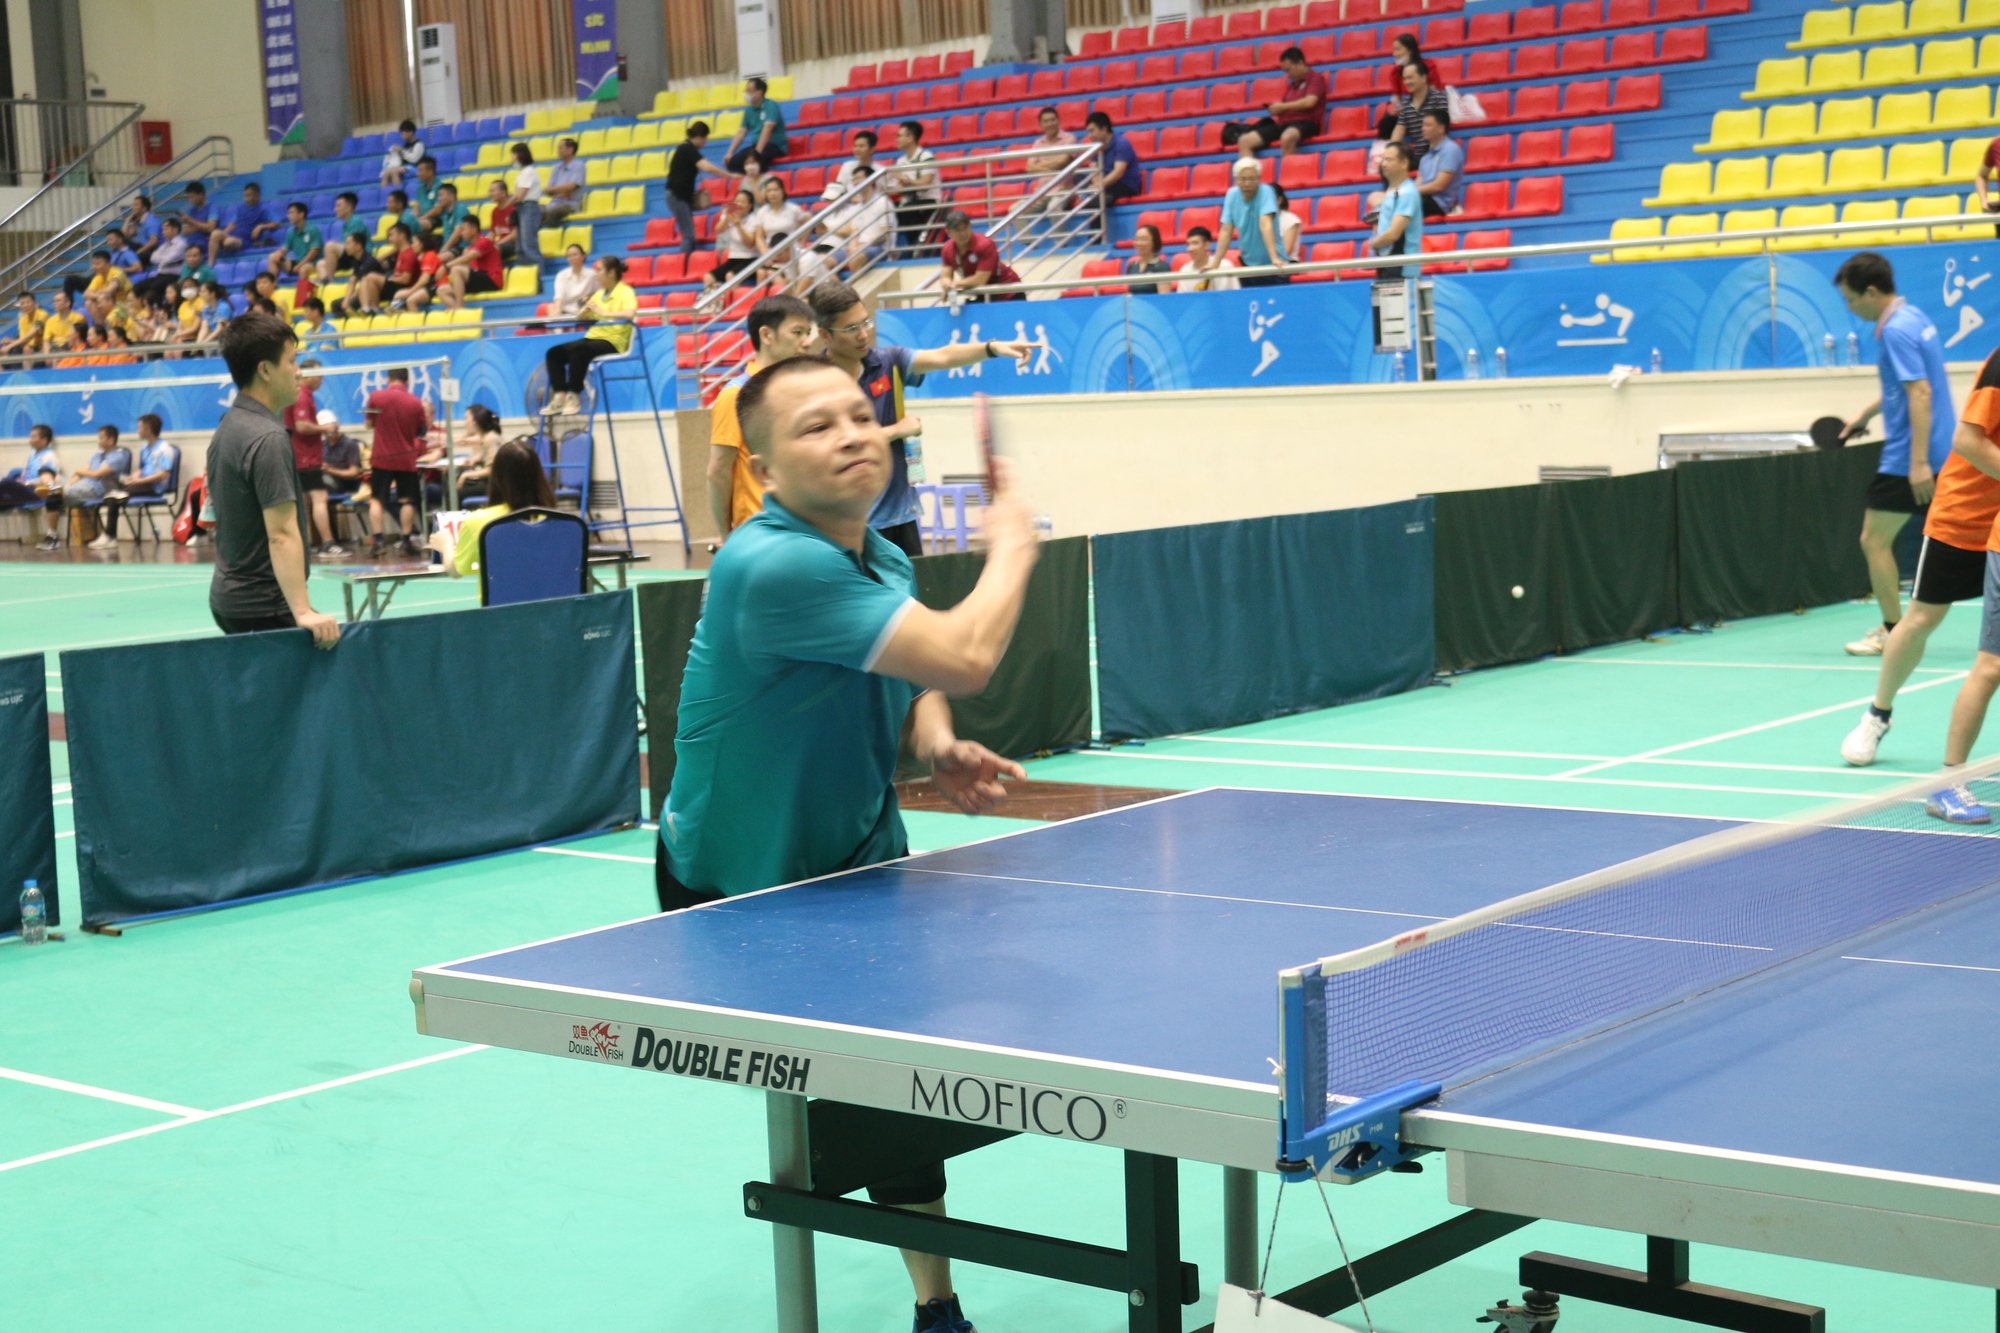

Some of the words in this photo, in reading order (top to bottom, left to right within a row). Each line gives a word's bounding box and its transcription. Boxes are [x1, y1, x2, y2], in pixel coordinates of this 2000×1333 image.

[569, 1040, 599, 1057] DOUBLE
[608, 1049, 623, 1060] FISH
[632, 1027, 743, 1082] DOUBLE
[746, 1051, 811, 1092] FISH
[911, 1069, 1107, 1141] MOFICO
[1327, 1122, 1364, 1152] DHS
